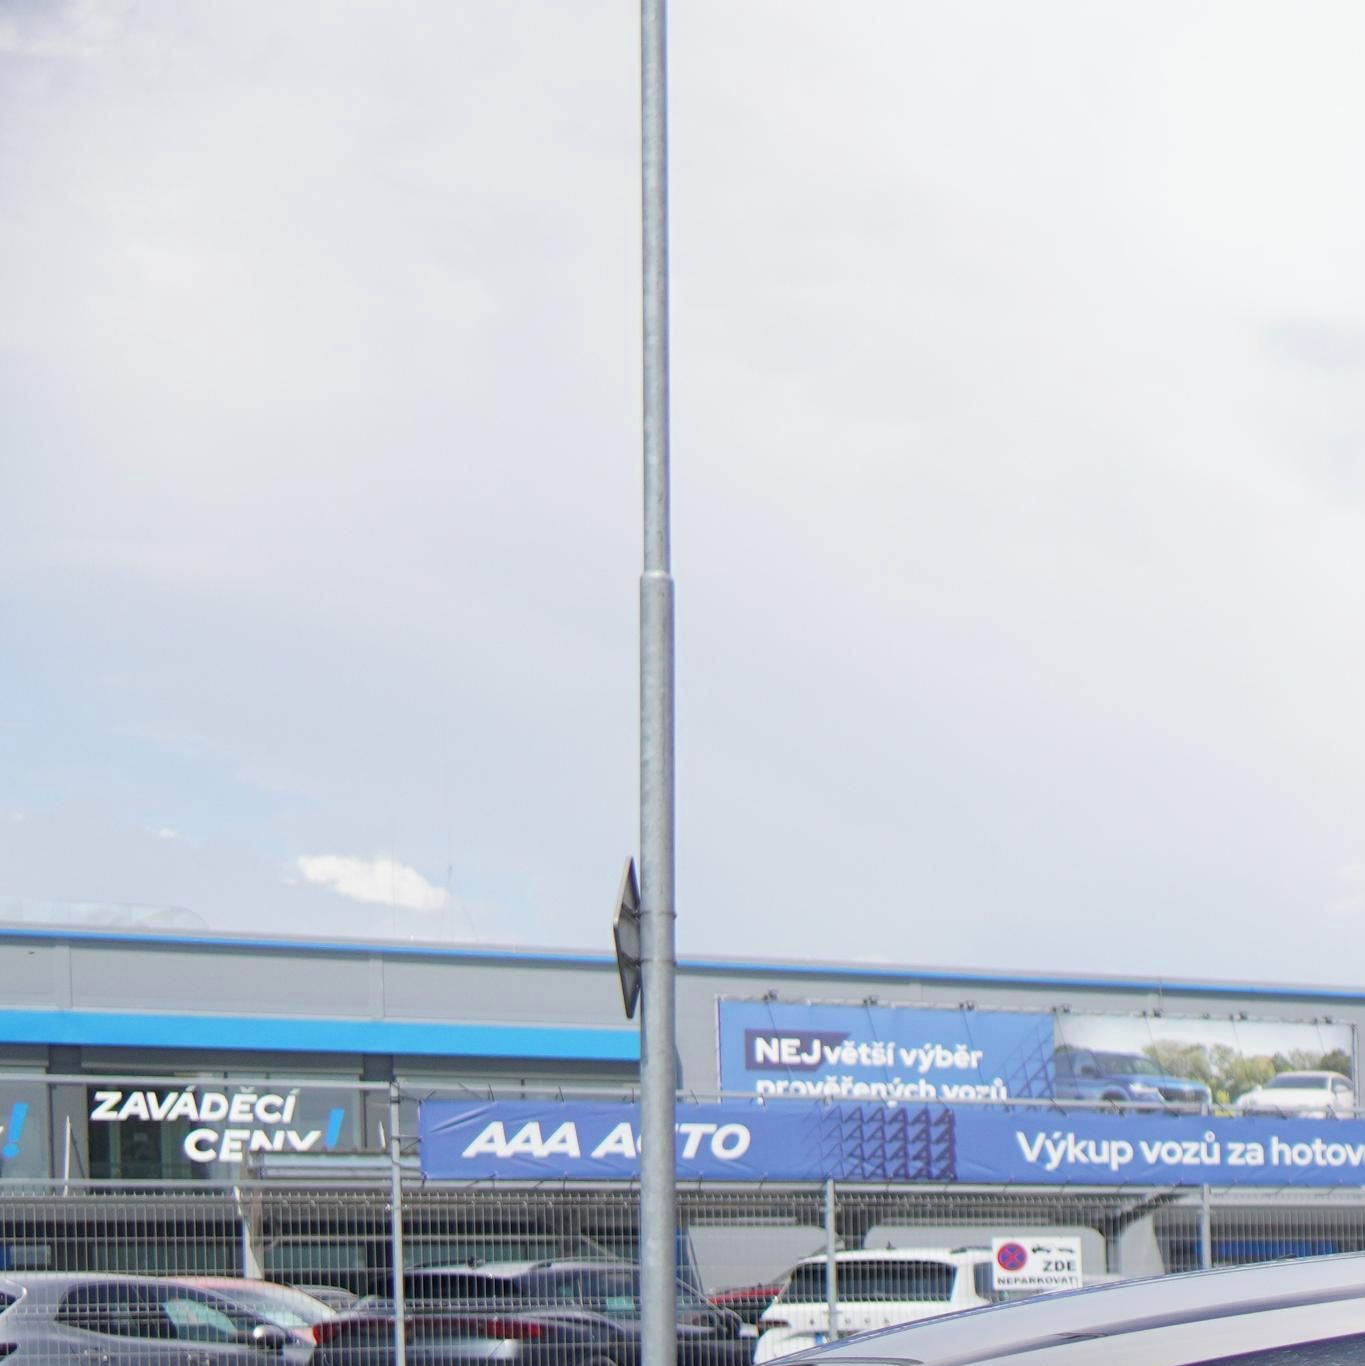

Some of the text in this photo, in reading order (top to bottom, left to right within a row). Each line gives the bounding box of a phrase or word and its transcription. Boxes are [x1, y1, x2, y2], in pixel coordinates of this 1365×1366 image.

[754, 1036, 984, 1073] NEJvětší výběr
[90, 1085, 301, 1123] ZAVÁDĚCÍ
[461, 1121, 752, 1160] AAA ATO
[1015, 1130, 1134, 1172] Výkup
[1139, 1130, 1221, 1166] vozů
[1226, 1140, 1265, 1166] za
